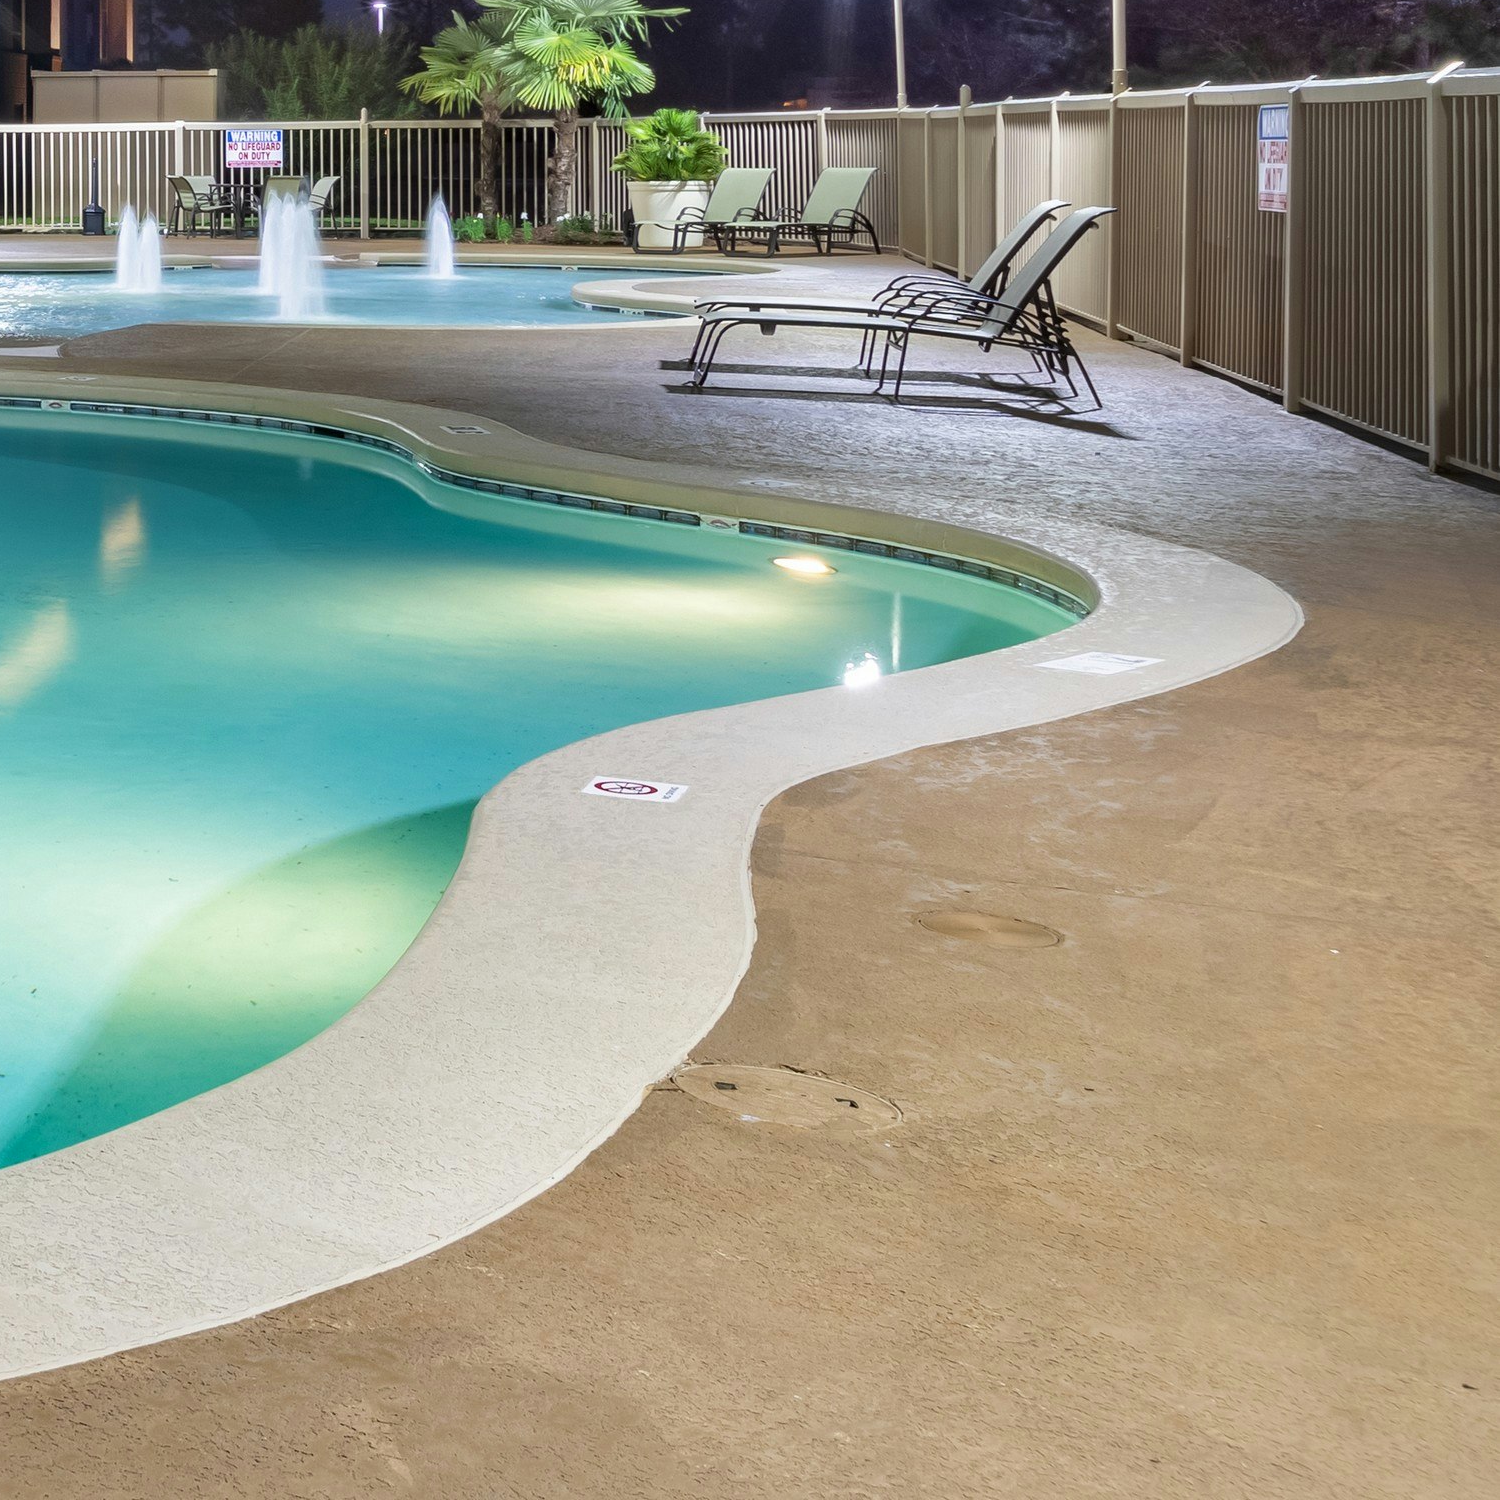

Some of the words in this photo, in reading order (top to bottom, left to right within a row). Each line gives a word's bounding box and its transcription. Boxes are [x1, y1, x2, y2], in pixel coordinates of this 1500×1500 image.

[231, 131, 278, 142] WARNING
[228, 142, 238, 151] NO
[241, 142, 281, 151] LIFEGUARD
[238, 152, 248, 160] ON
[251, 152, 271, 160] DUTY
